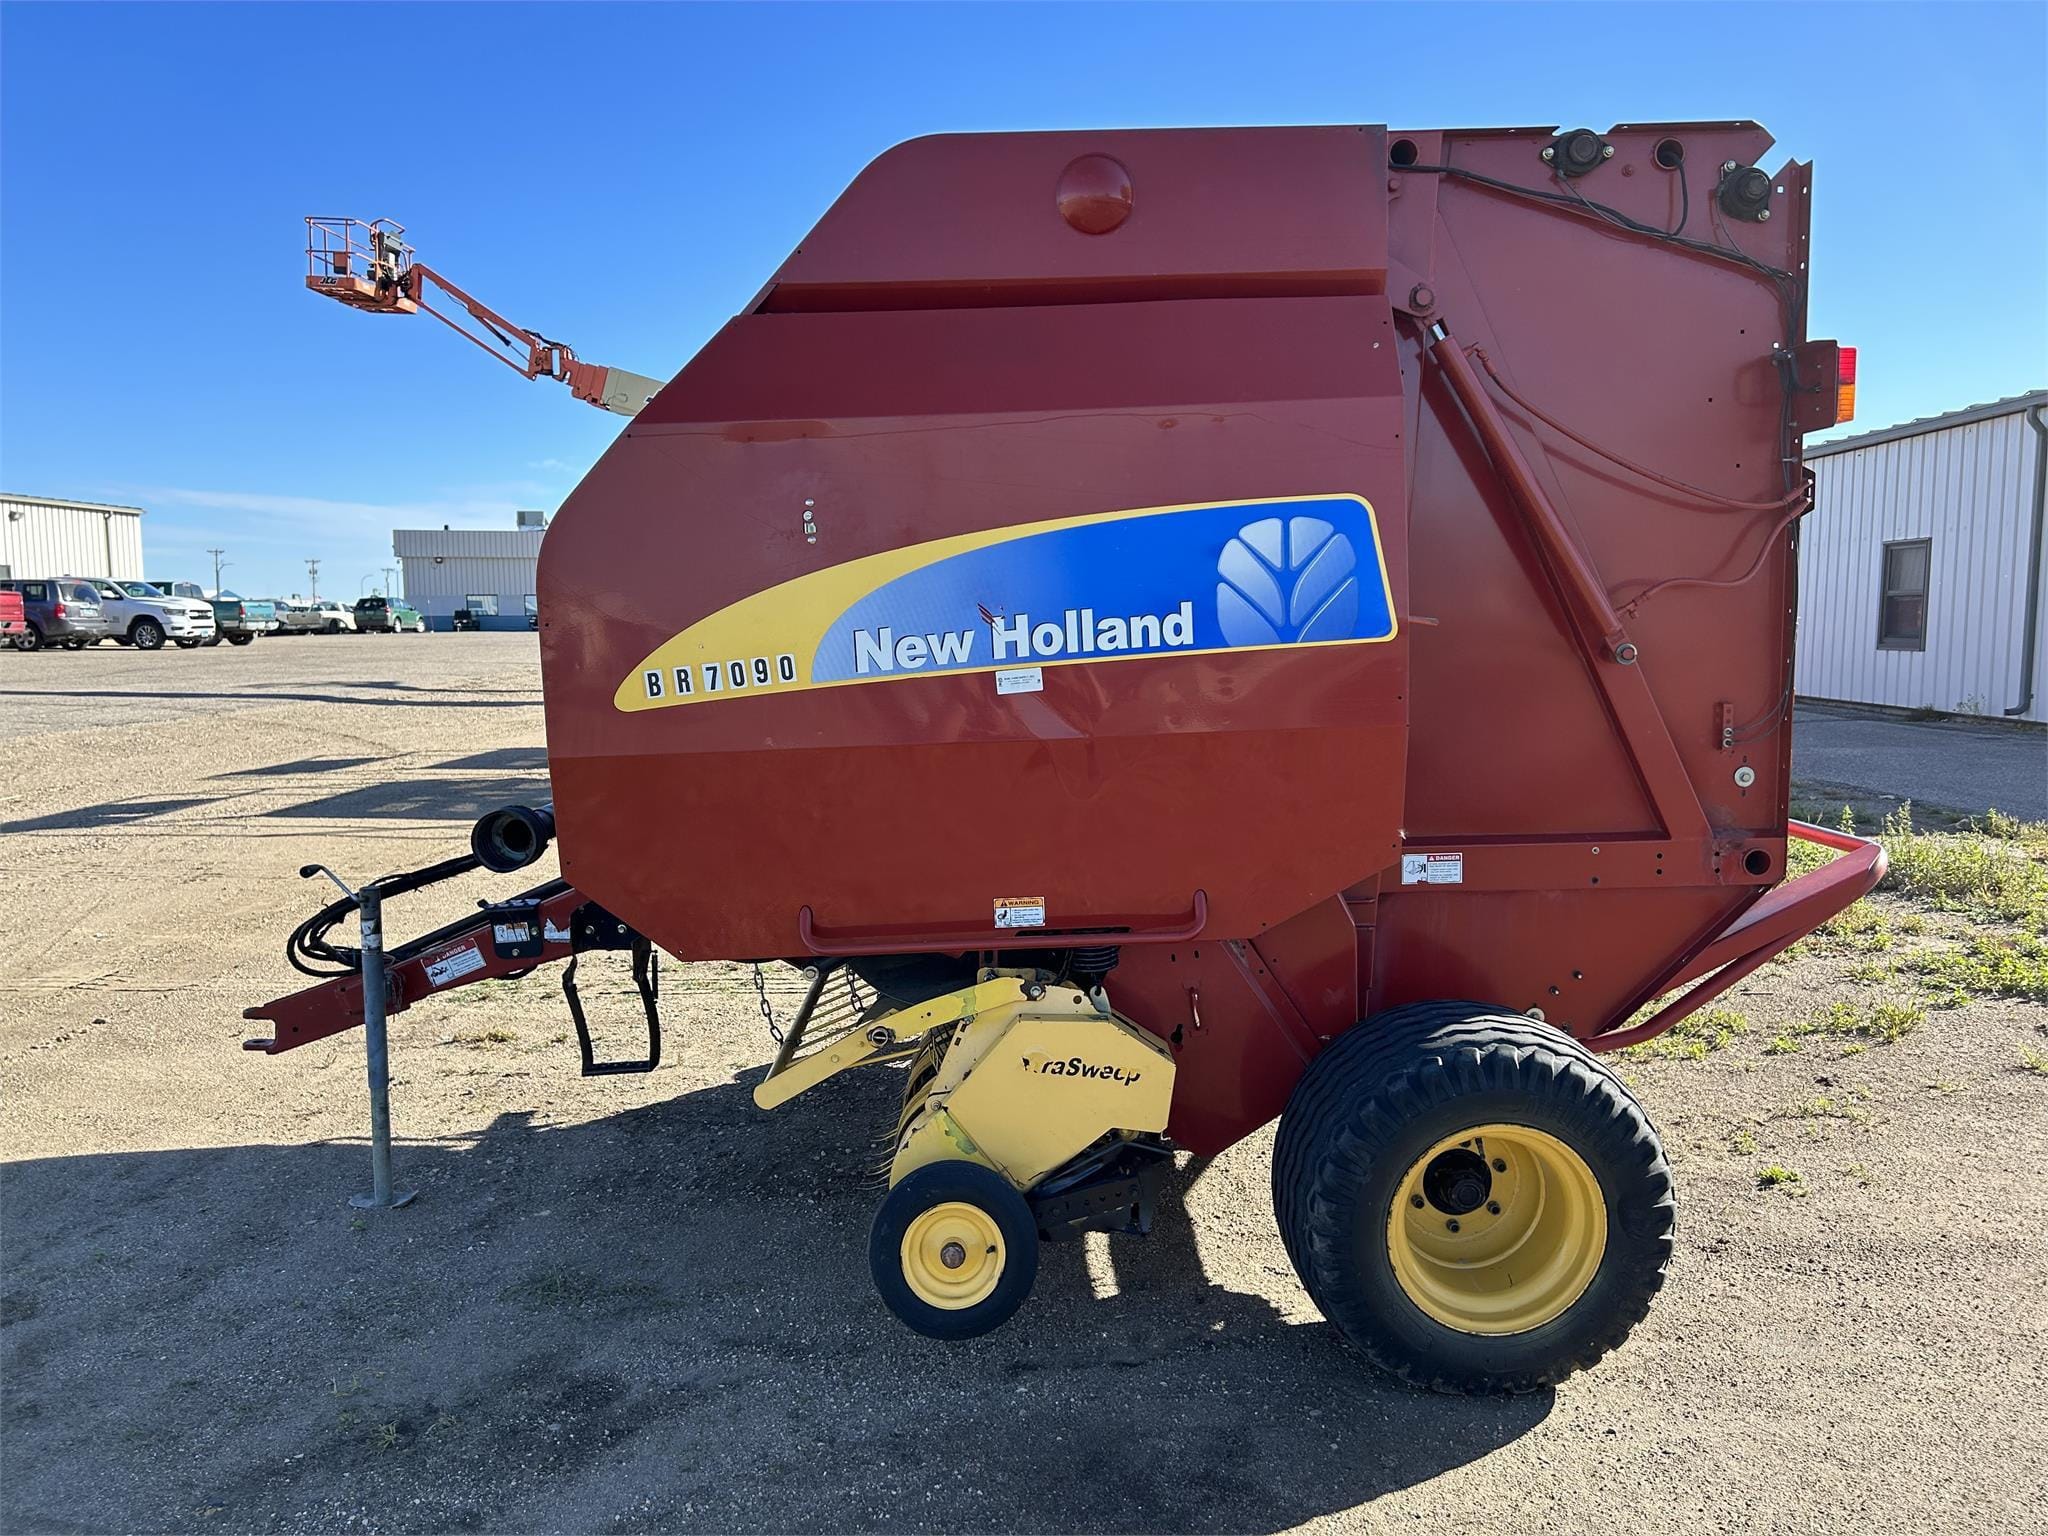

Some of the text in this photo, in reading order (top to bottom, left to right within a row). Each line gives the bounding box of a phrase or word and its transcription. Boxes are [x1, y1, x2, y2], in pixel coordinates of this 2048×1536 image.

[319, 276, 337, 284] JLG
[853, 601, 1194, 673] New Holland
